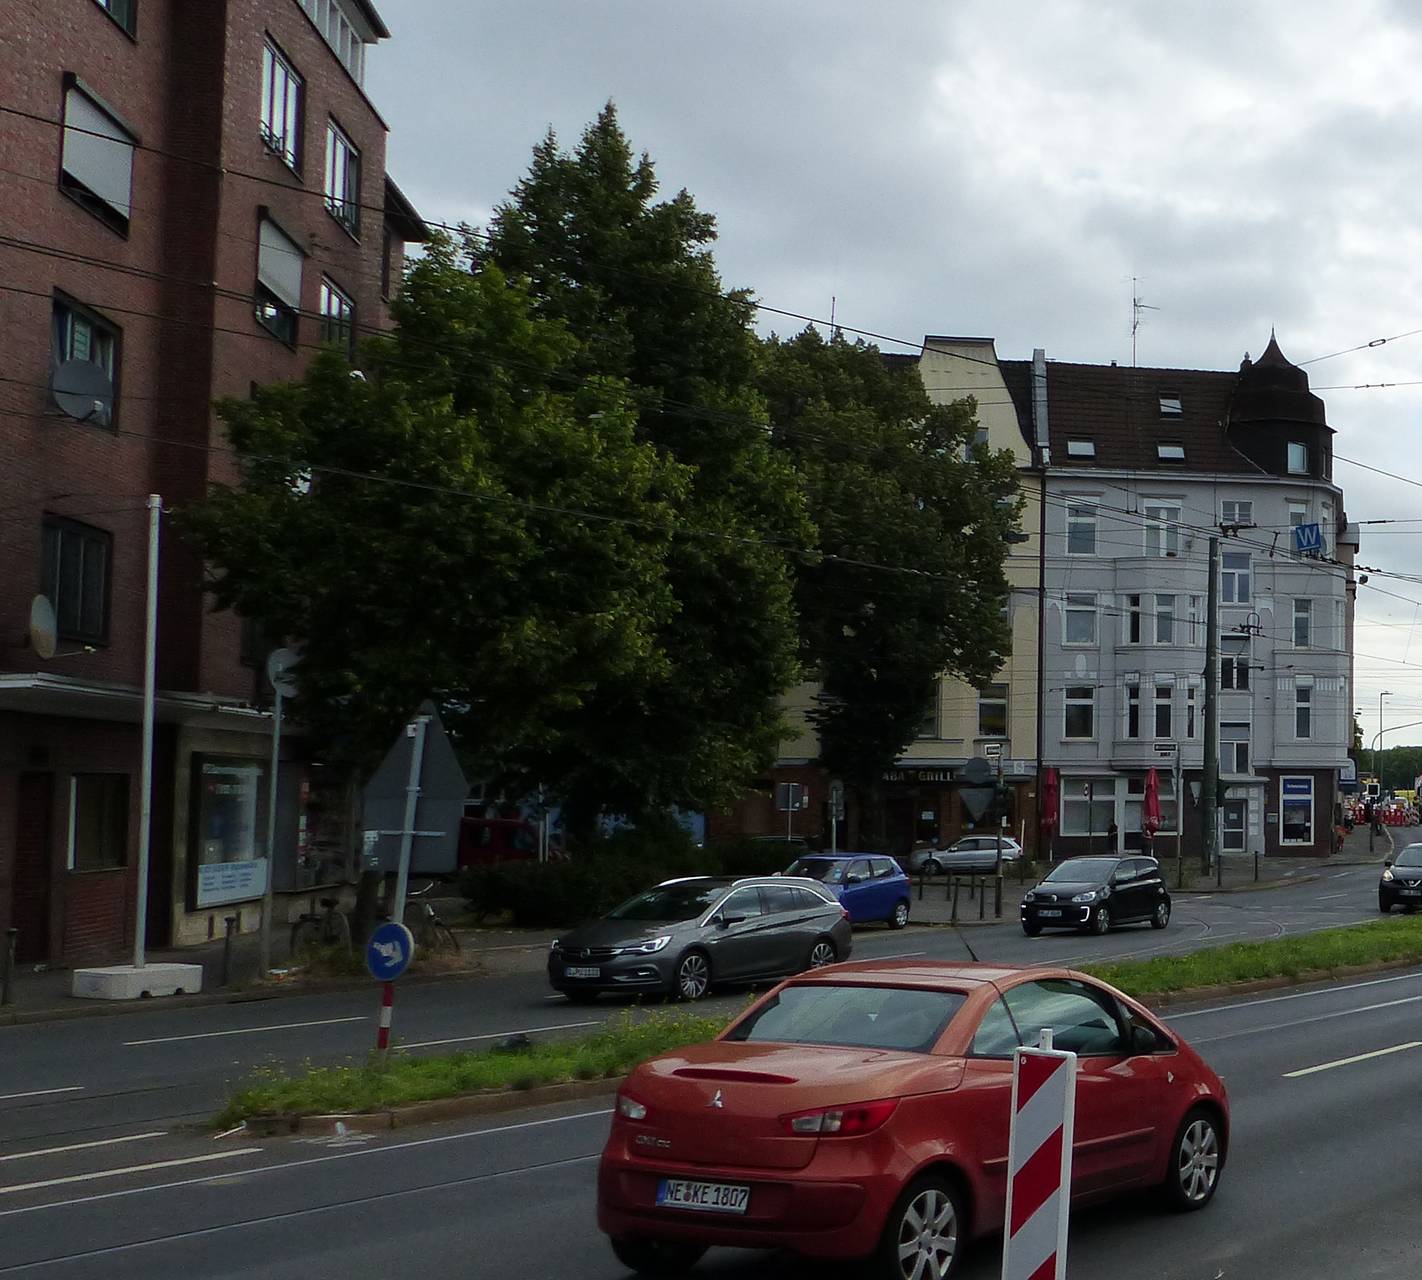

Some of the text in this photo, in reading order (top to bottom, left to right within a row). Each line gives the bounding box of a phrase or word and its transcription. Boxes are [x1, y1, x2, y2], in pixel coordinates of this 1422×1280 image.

[1297, 525, 1318, 546] W
[666, 1182, 749, 1207] NE KE 1807
